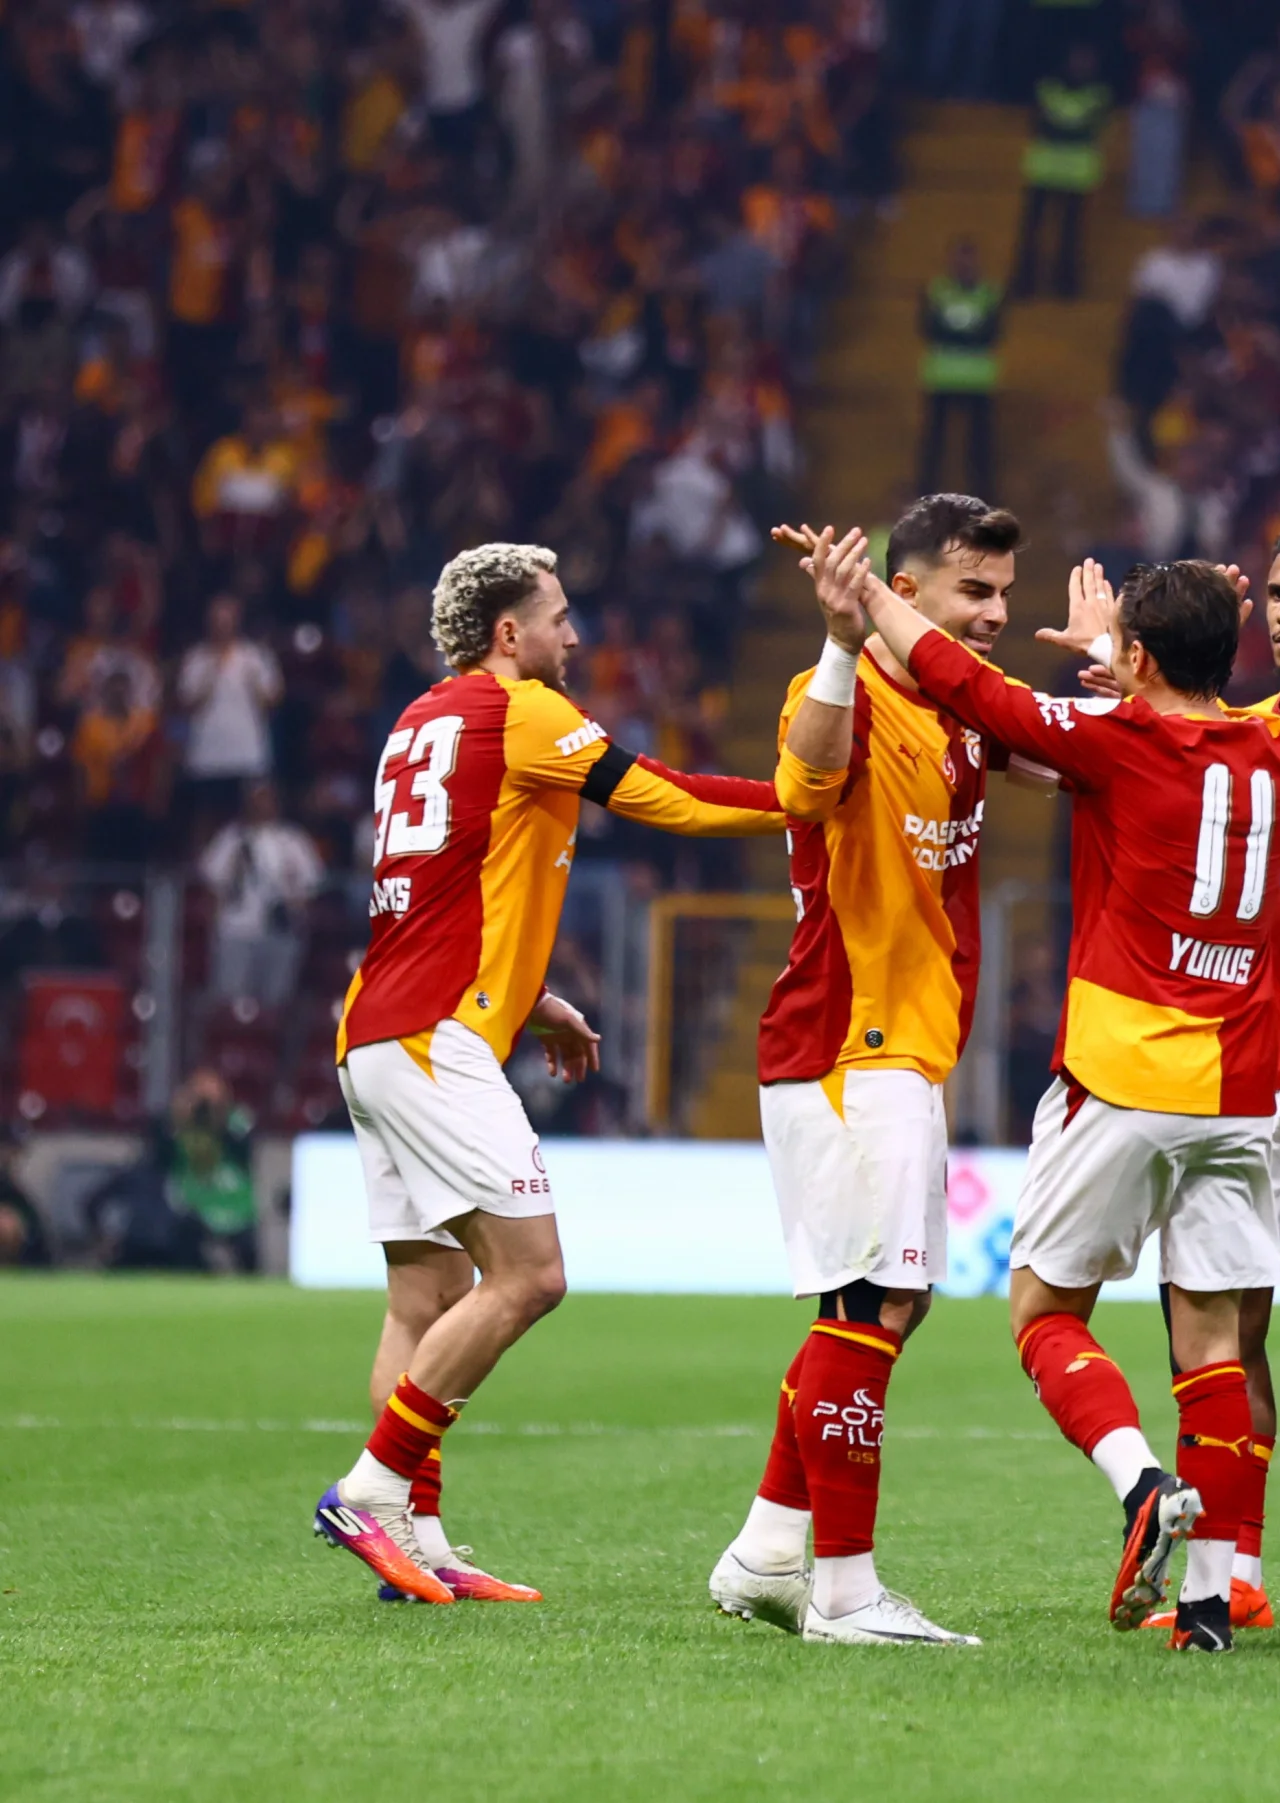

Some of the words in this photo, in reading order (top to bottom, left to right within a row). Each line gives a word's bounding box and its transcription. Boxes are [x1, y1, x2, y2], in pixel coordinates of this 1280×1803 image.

[373, 716, 465, 868] 53
[1188, 762, 1276, 924] 11
[1169, 932, 1255, 985] YUNUS
